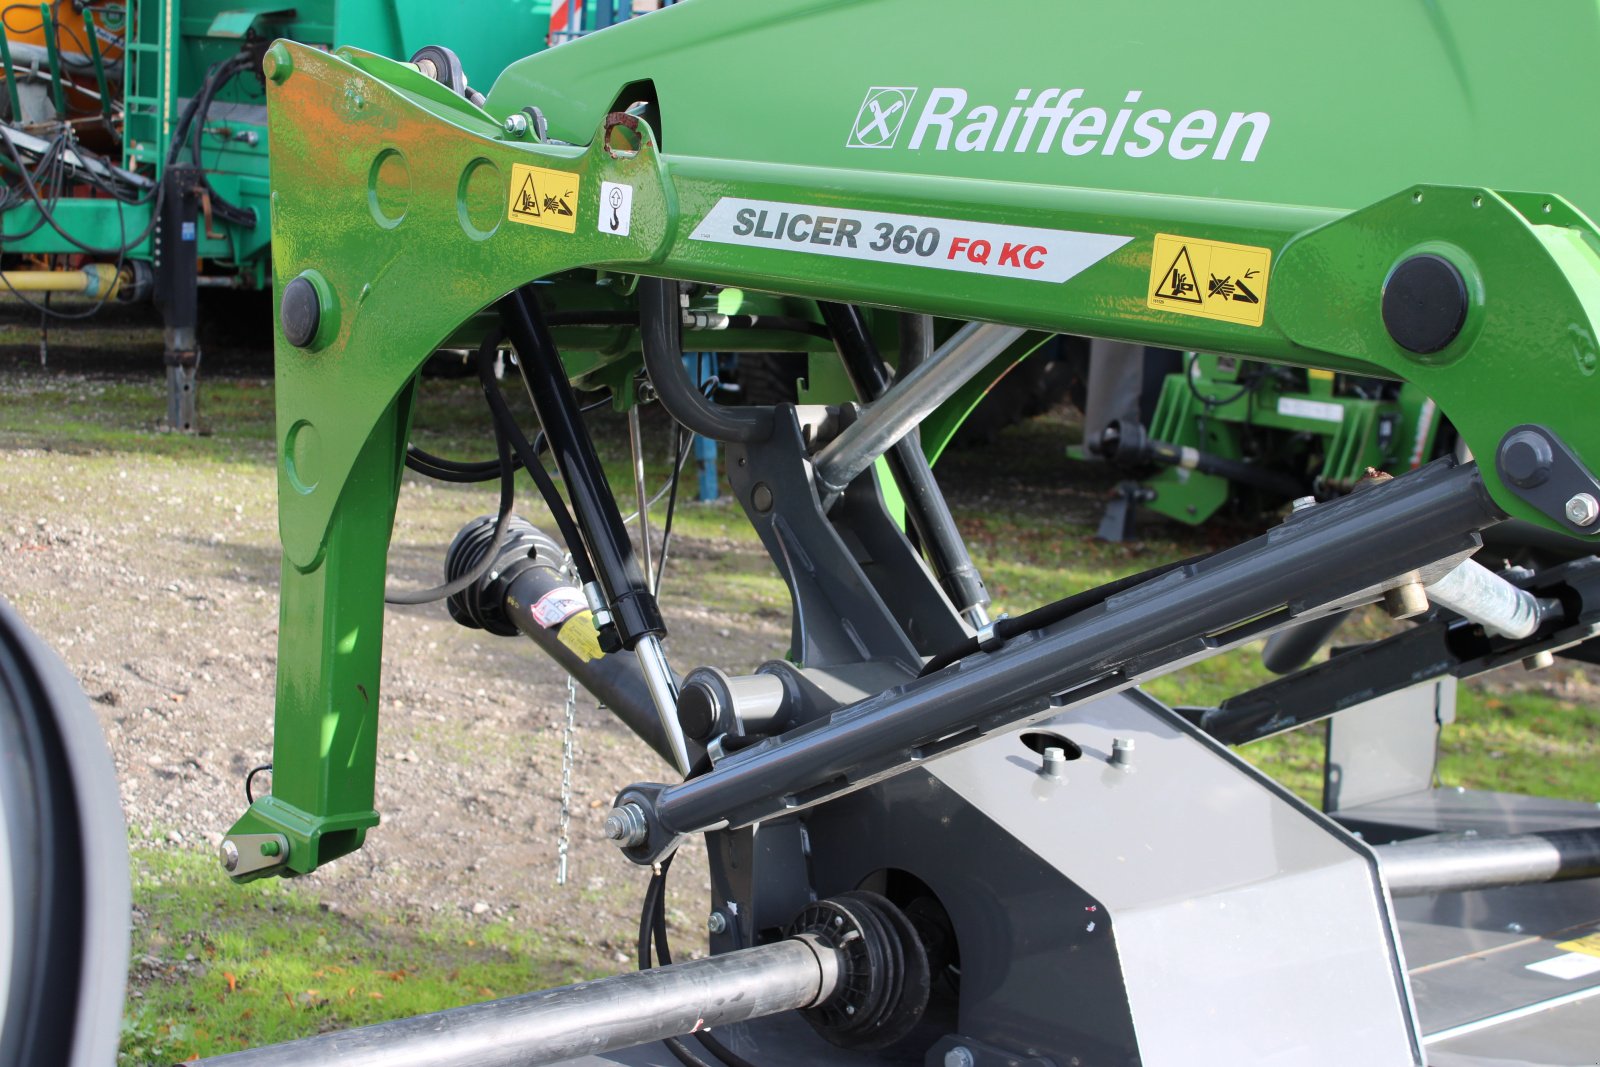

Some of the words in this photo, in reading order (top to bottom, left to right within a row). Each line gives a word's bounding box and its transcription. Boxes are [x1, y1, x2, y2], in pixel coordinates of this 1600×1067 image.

[908, 87, 1270, 162] Raiffeisen
[732, 208, 861, 249] SLICER
[870, 222, 941, 258] 360
[947, 237, 992, 265] FQ
[998, 244, 1048, 270] KC
